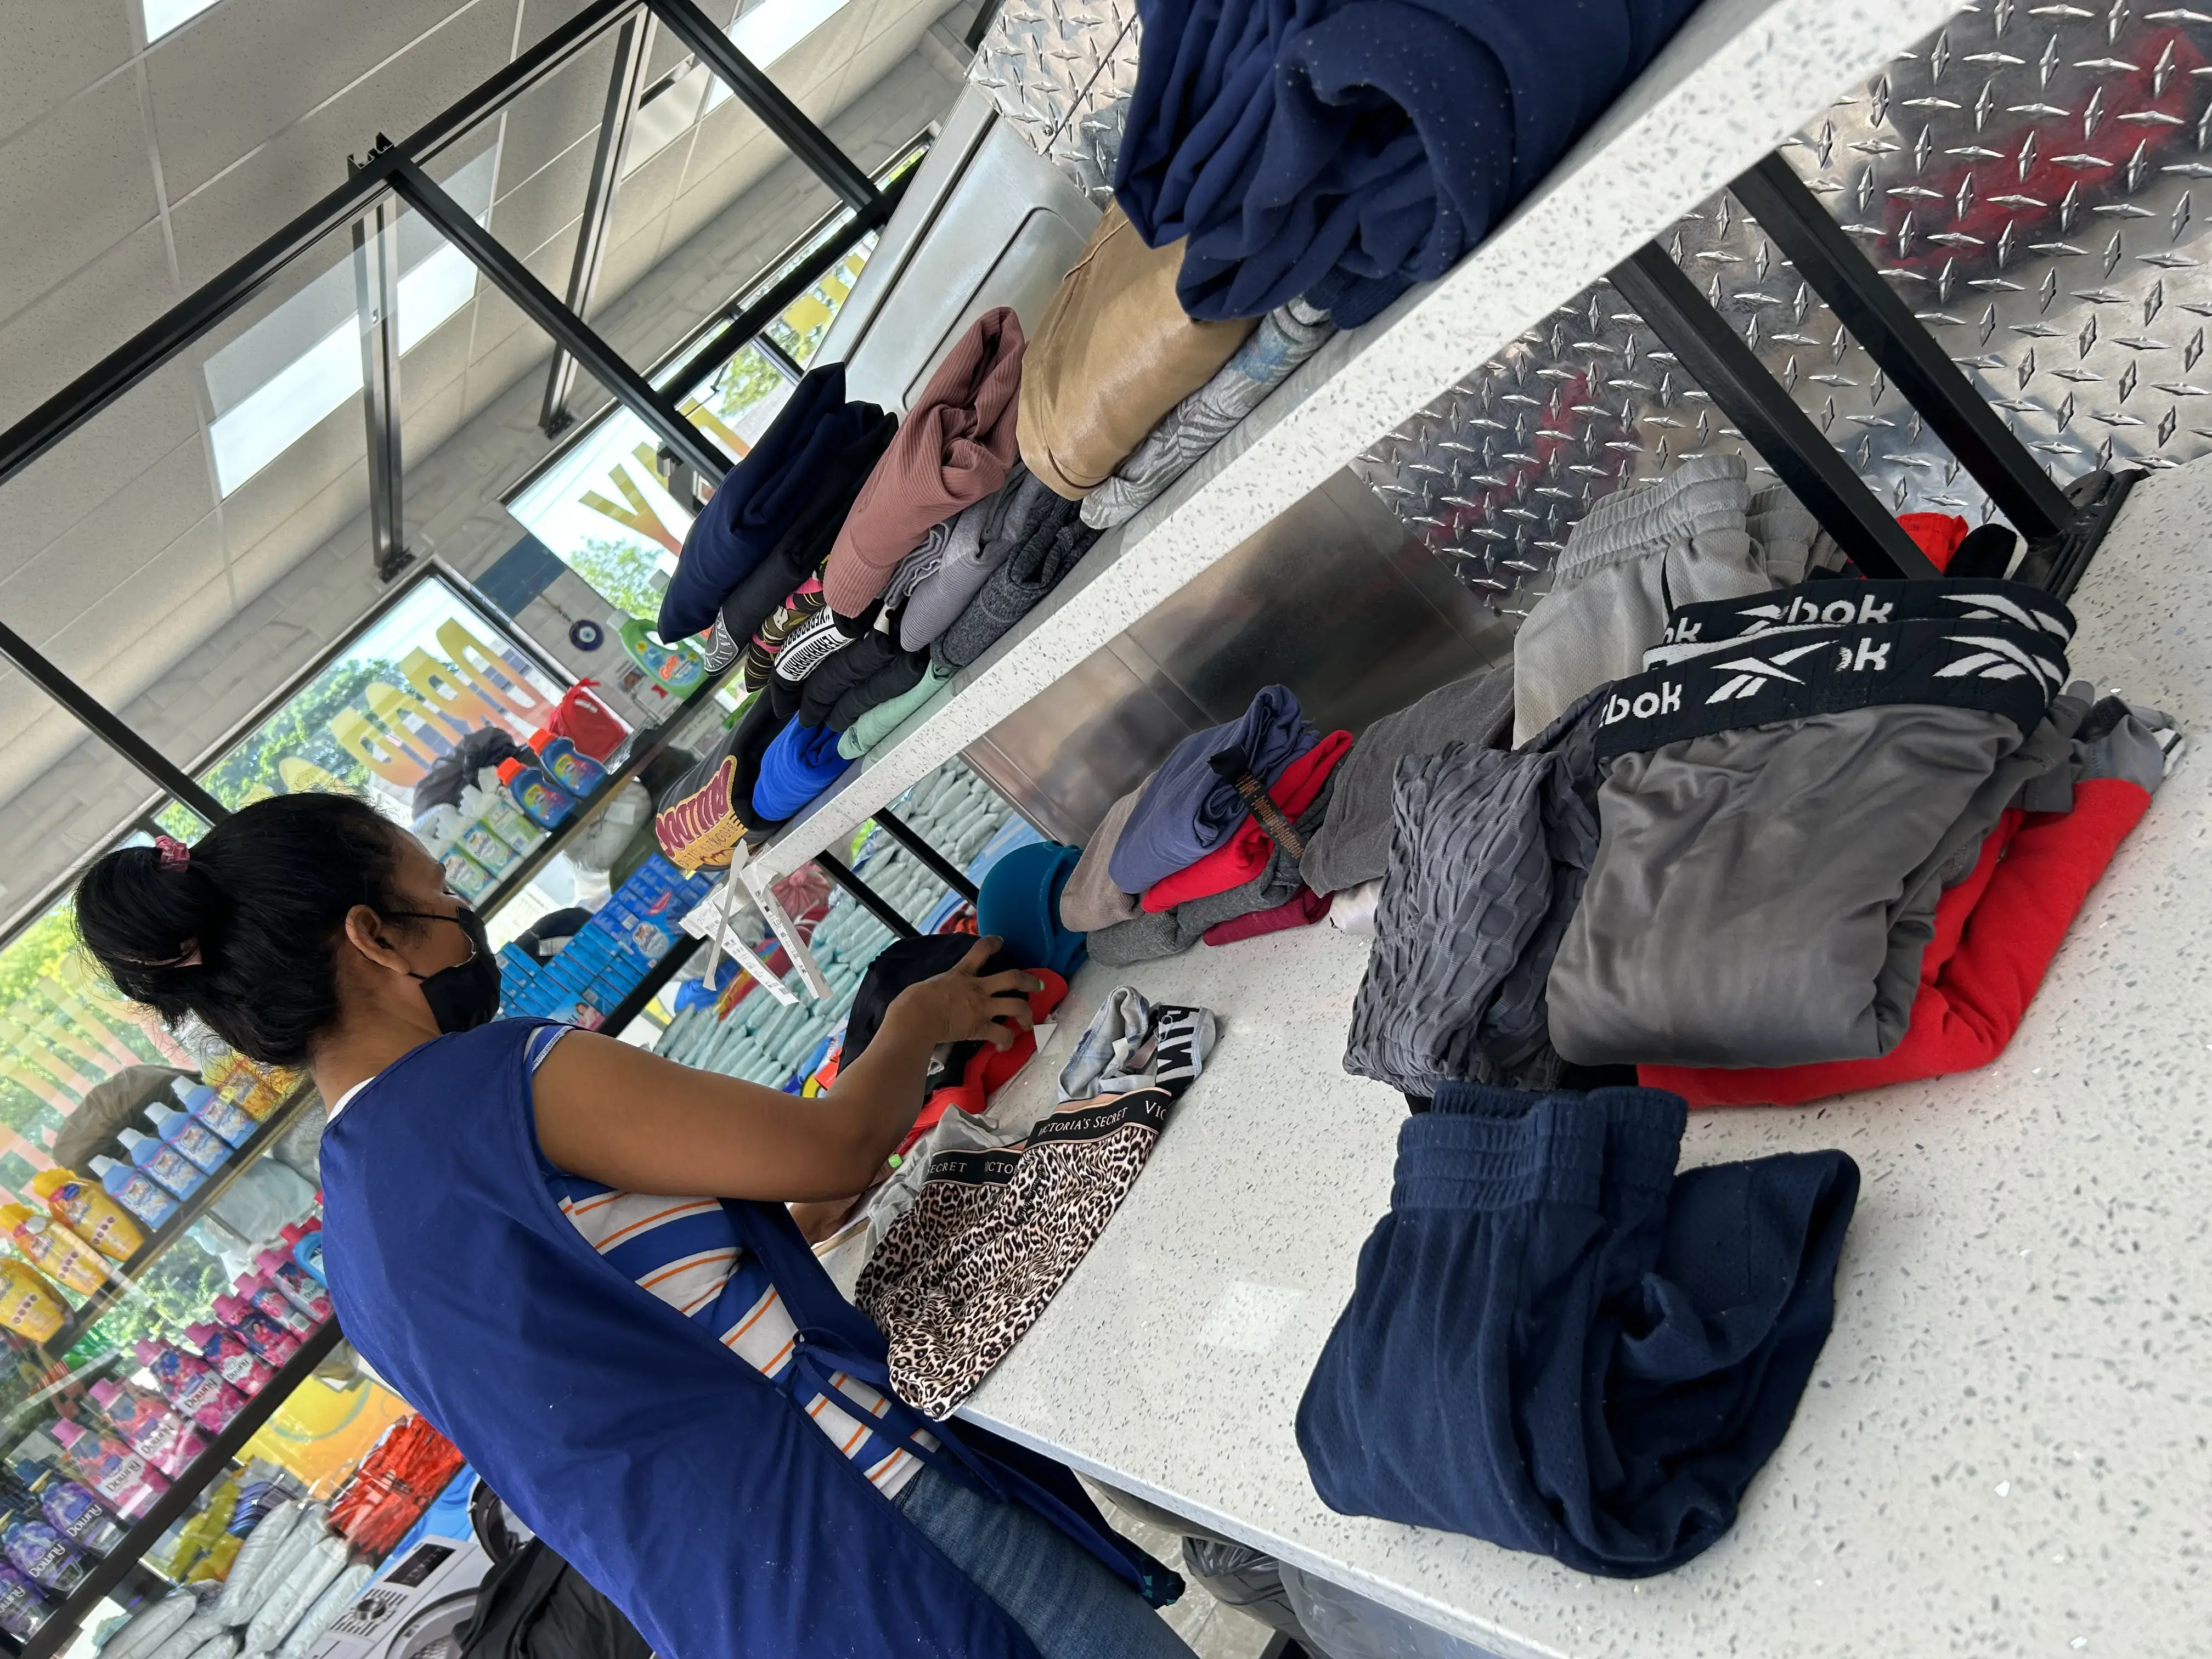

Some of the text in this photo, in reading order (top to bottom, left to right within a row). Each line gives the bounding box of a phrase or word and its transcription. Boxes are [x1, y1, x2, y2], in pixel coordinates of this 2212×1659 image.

[1093, 1106, 1128, 1128] SECRET
[184, 1377, 218, 1409] Downy
[105, 1459, 142, 1492] Downy
[66, 1503, 103, 1537] Downy
[28, 1542, 66, 1578] Downy
[0, 1585, 26, 1614] owny
